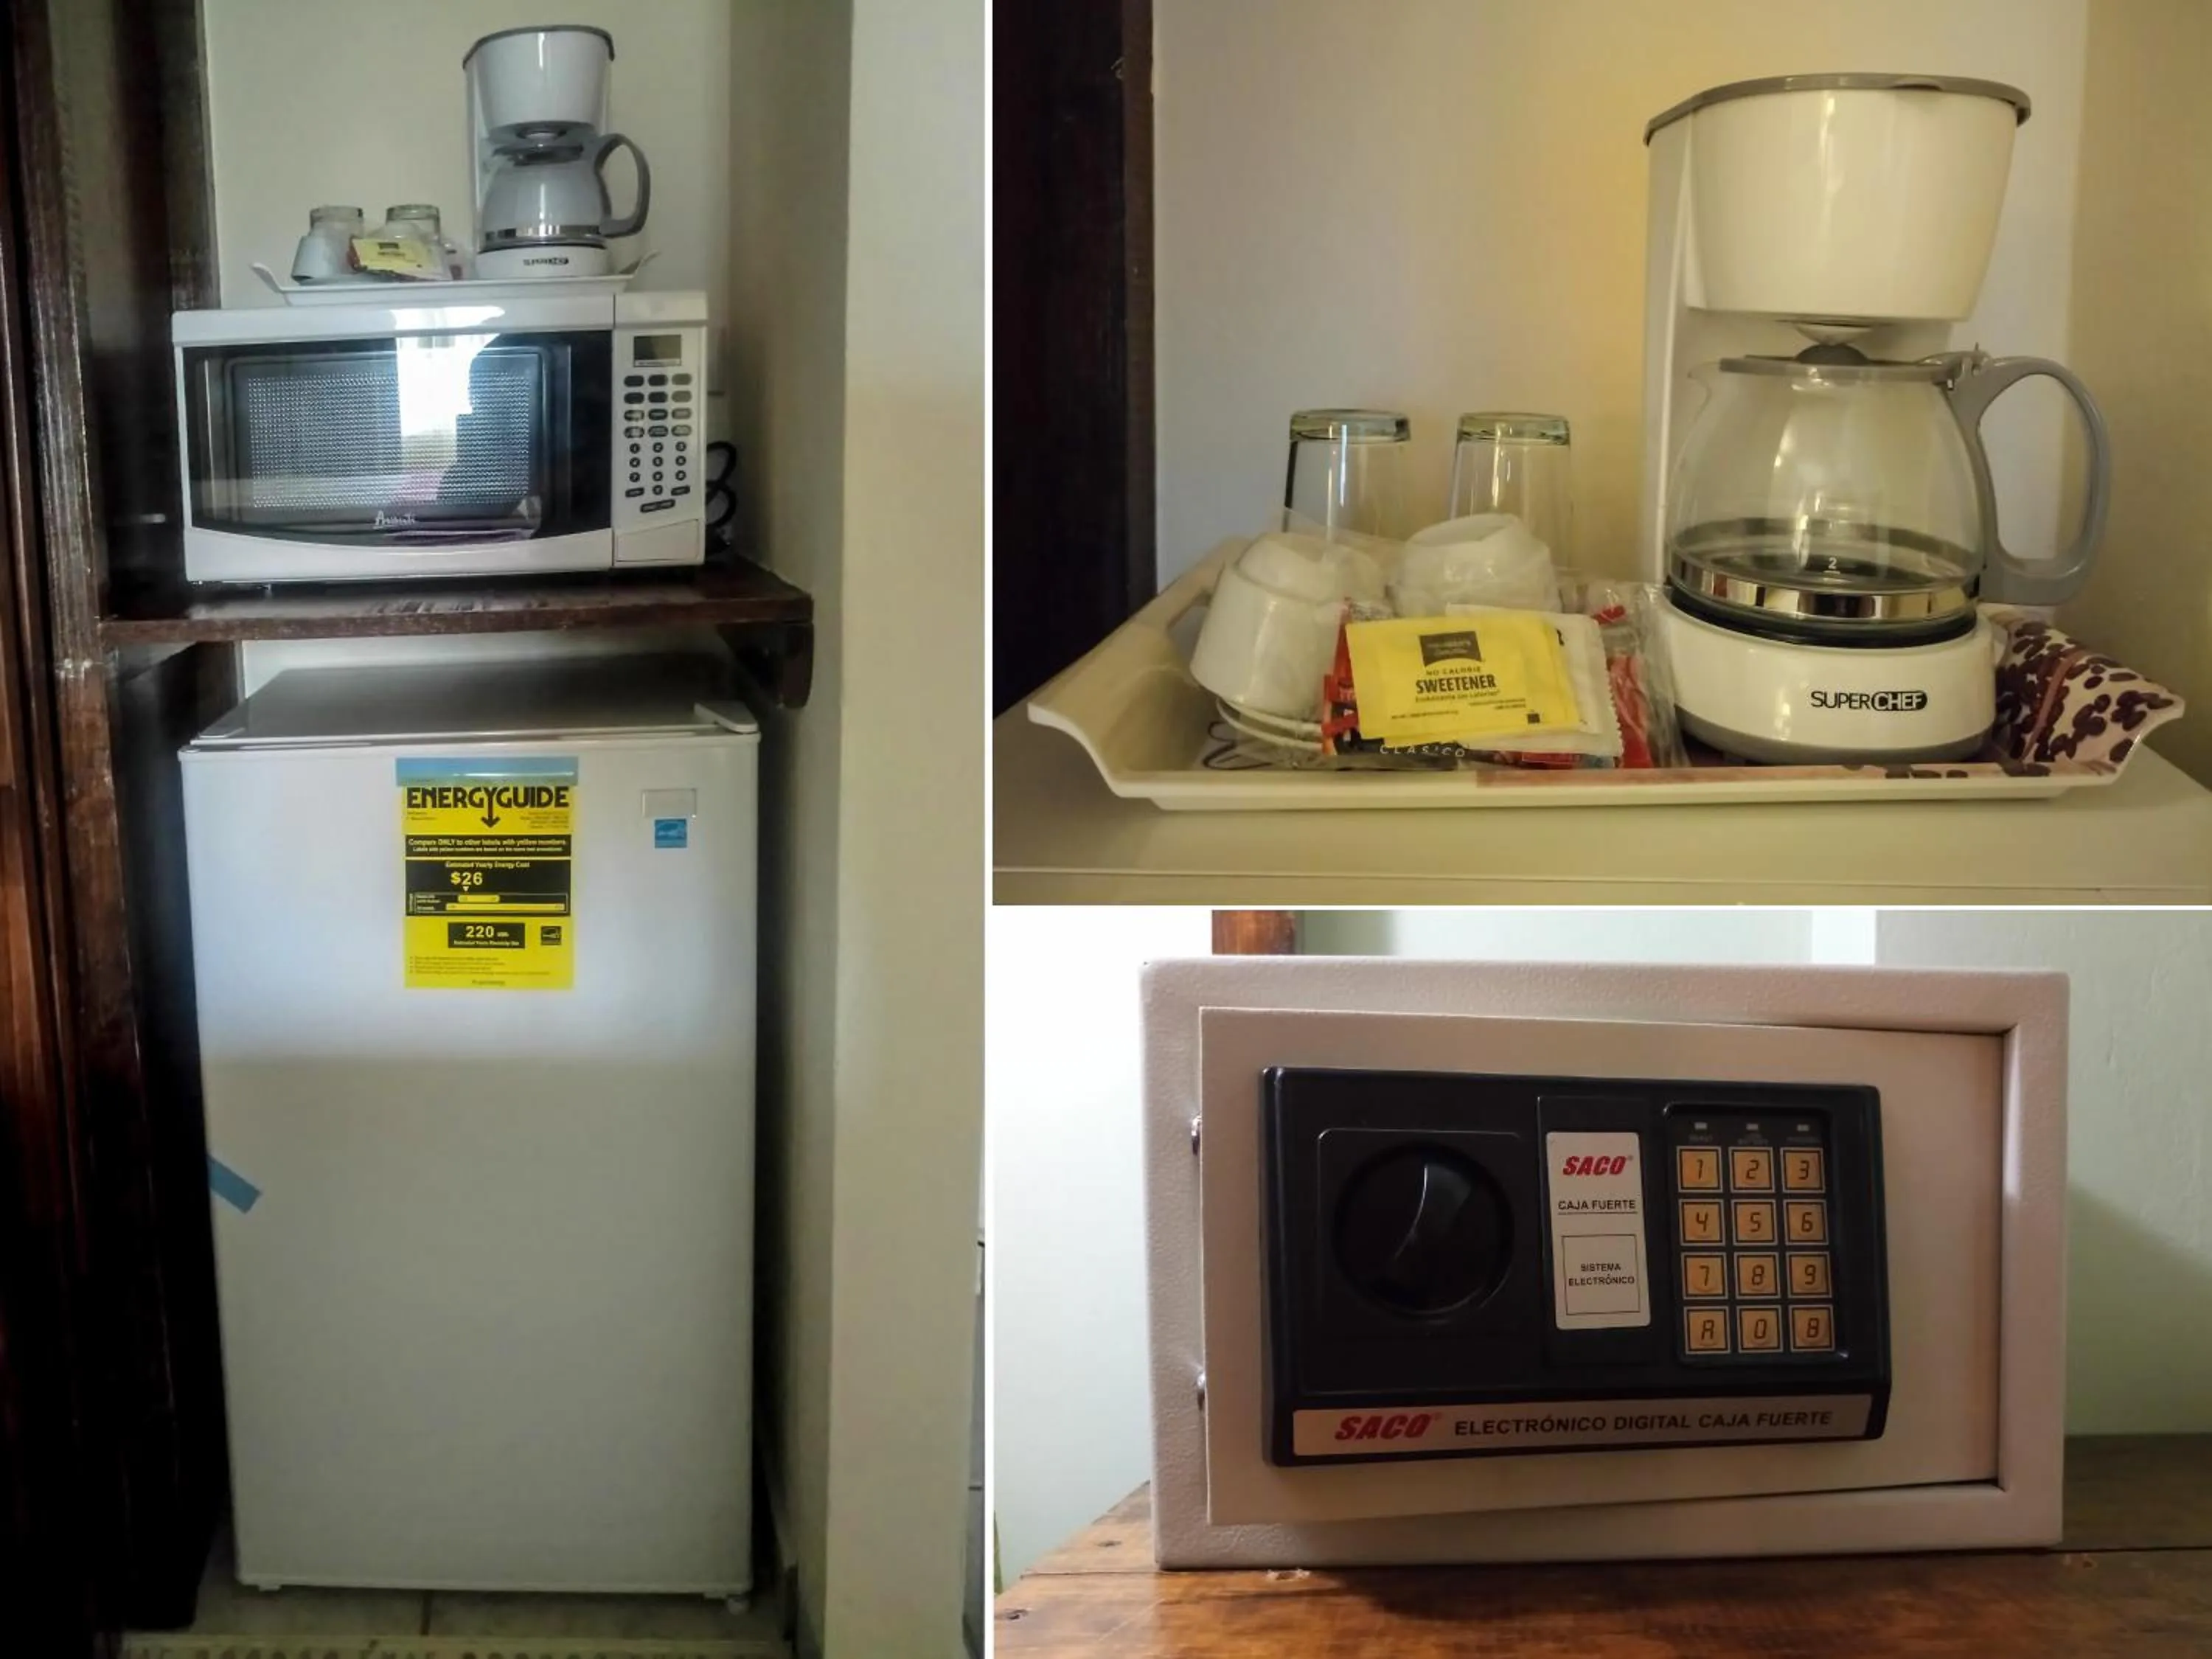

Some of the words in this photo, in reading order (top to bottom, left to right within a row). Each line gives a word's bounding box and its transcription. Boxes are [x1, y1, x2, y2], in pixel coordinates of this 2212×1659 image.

[1828, 557, 1837, 569] 2
[1415, 674, 1497, 695] SWEETENER
[1810, 691, 1928, 711] SUPERCHEF
[406, 786, 570, 809] ENERGYGUIDE
[450, 871, 483, 886] $26
[465, 925, 495, 938] 220
[1562, 1155, 1627, 1176] SACO
[1696, 1160, 1704, 1179] 1
[1746, 1159, 1760, 1180] 2
[1798, 1159, 1809, 1180] 3
[1558, 1200, 1588, 1211] CAJA
[1592, 1199, 1636, 1210] FUERTE
[1694, 1212, 1708, 1232] 4
[1749, 1211, 1761, 1232] 5
[1801, 1211, 1812, 1232] 6
[1580, 1262, 1621, 1272] SISTEMA
[1699, 1265, 1711, 1286] 7
[1752, 1265, 1764, 1285] 8
[1804, 1265, 1816, 1284] 9
[1568, 1273, 1635, 1287] ELECTRÓNICO
[1334, 1413, 1432, 1441] SACO
[1454, 1414, 1606, 1436] ELECTRÓNICO
[1613, 1414, 1691, 1430] DIGITAL
[1697, 1413, 1750, 1428] CAJA
[1756, 1411, 1833, 1427] FUERTE
